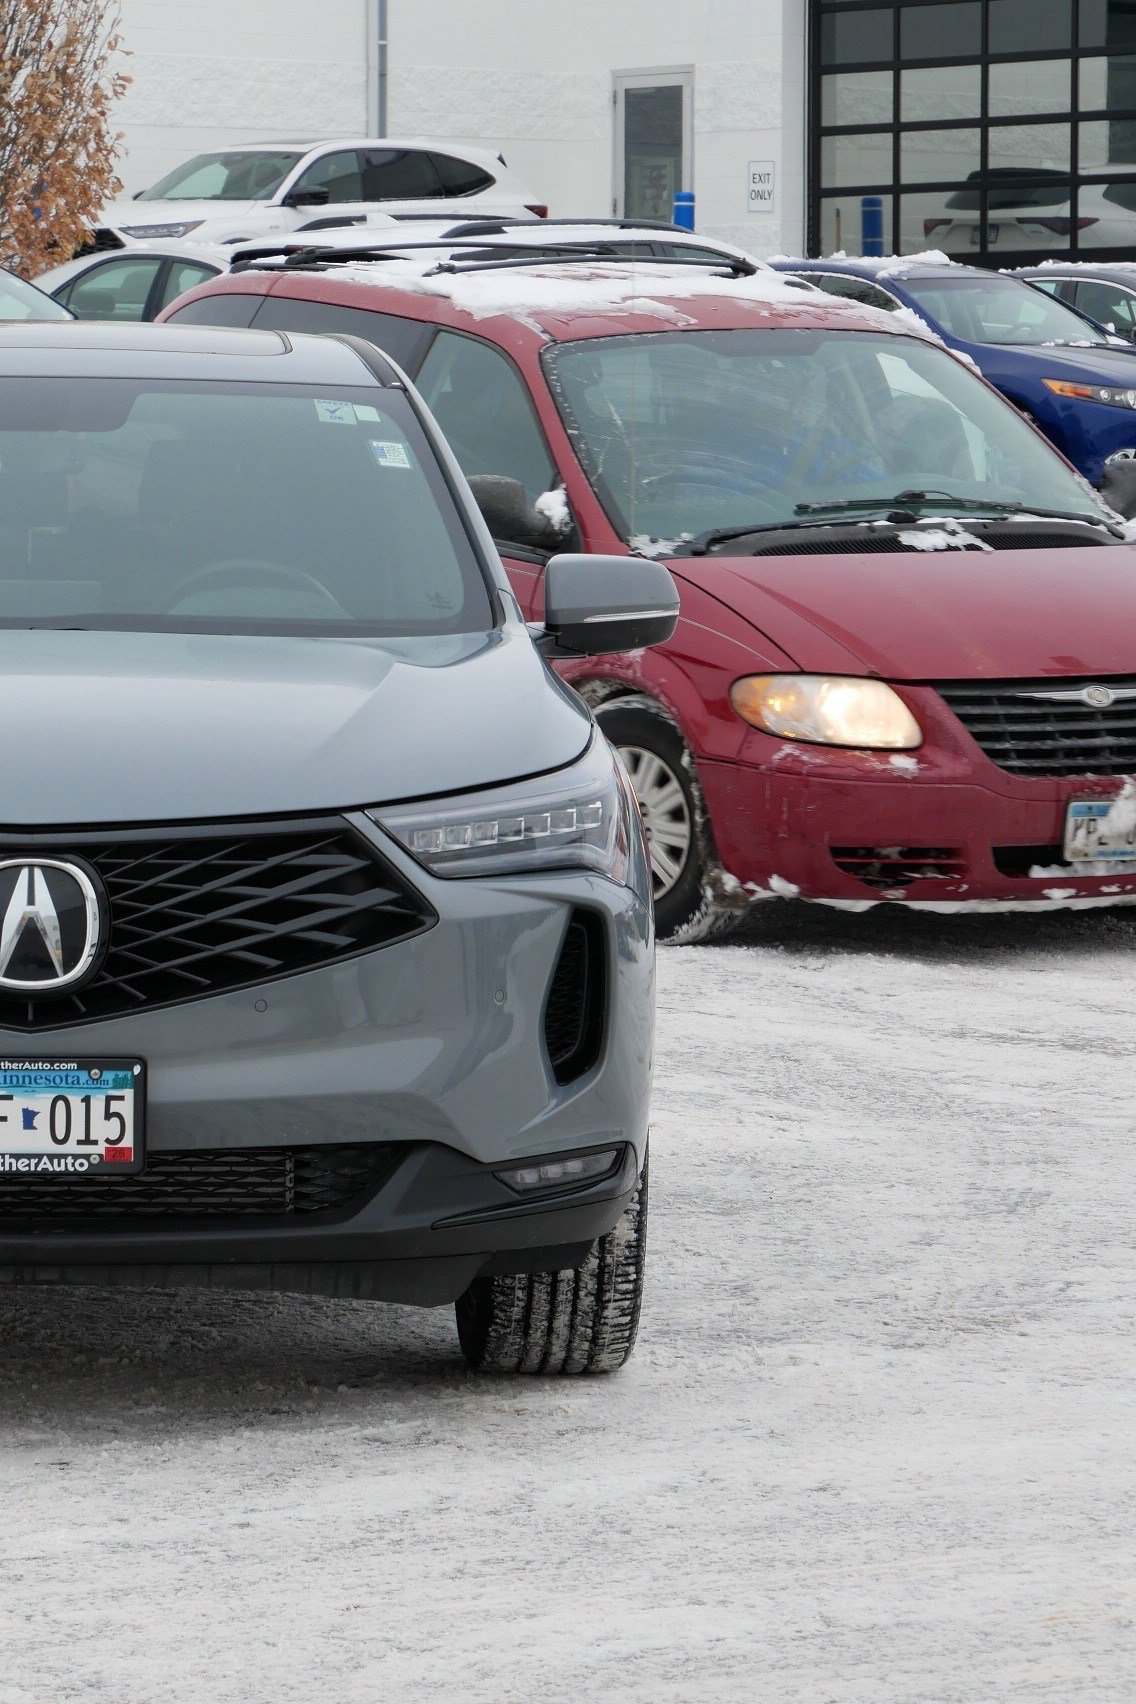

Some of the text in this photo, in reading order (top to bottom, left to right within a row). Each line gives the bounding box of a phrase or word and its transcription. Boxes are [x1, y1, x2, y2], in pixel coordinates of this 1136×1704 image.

[752, 173, 771, 184] EXIT
[750, 189, 773, 201] ONLY
[49, 1094, 126, 1146] 015
